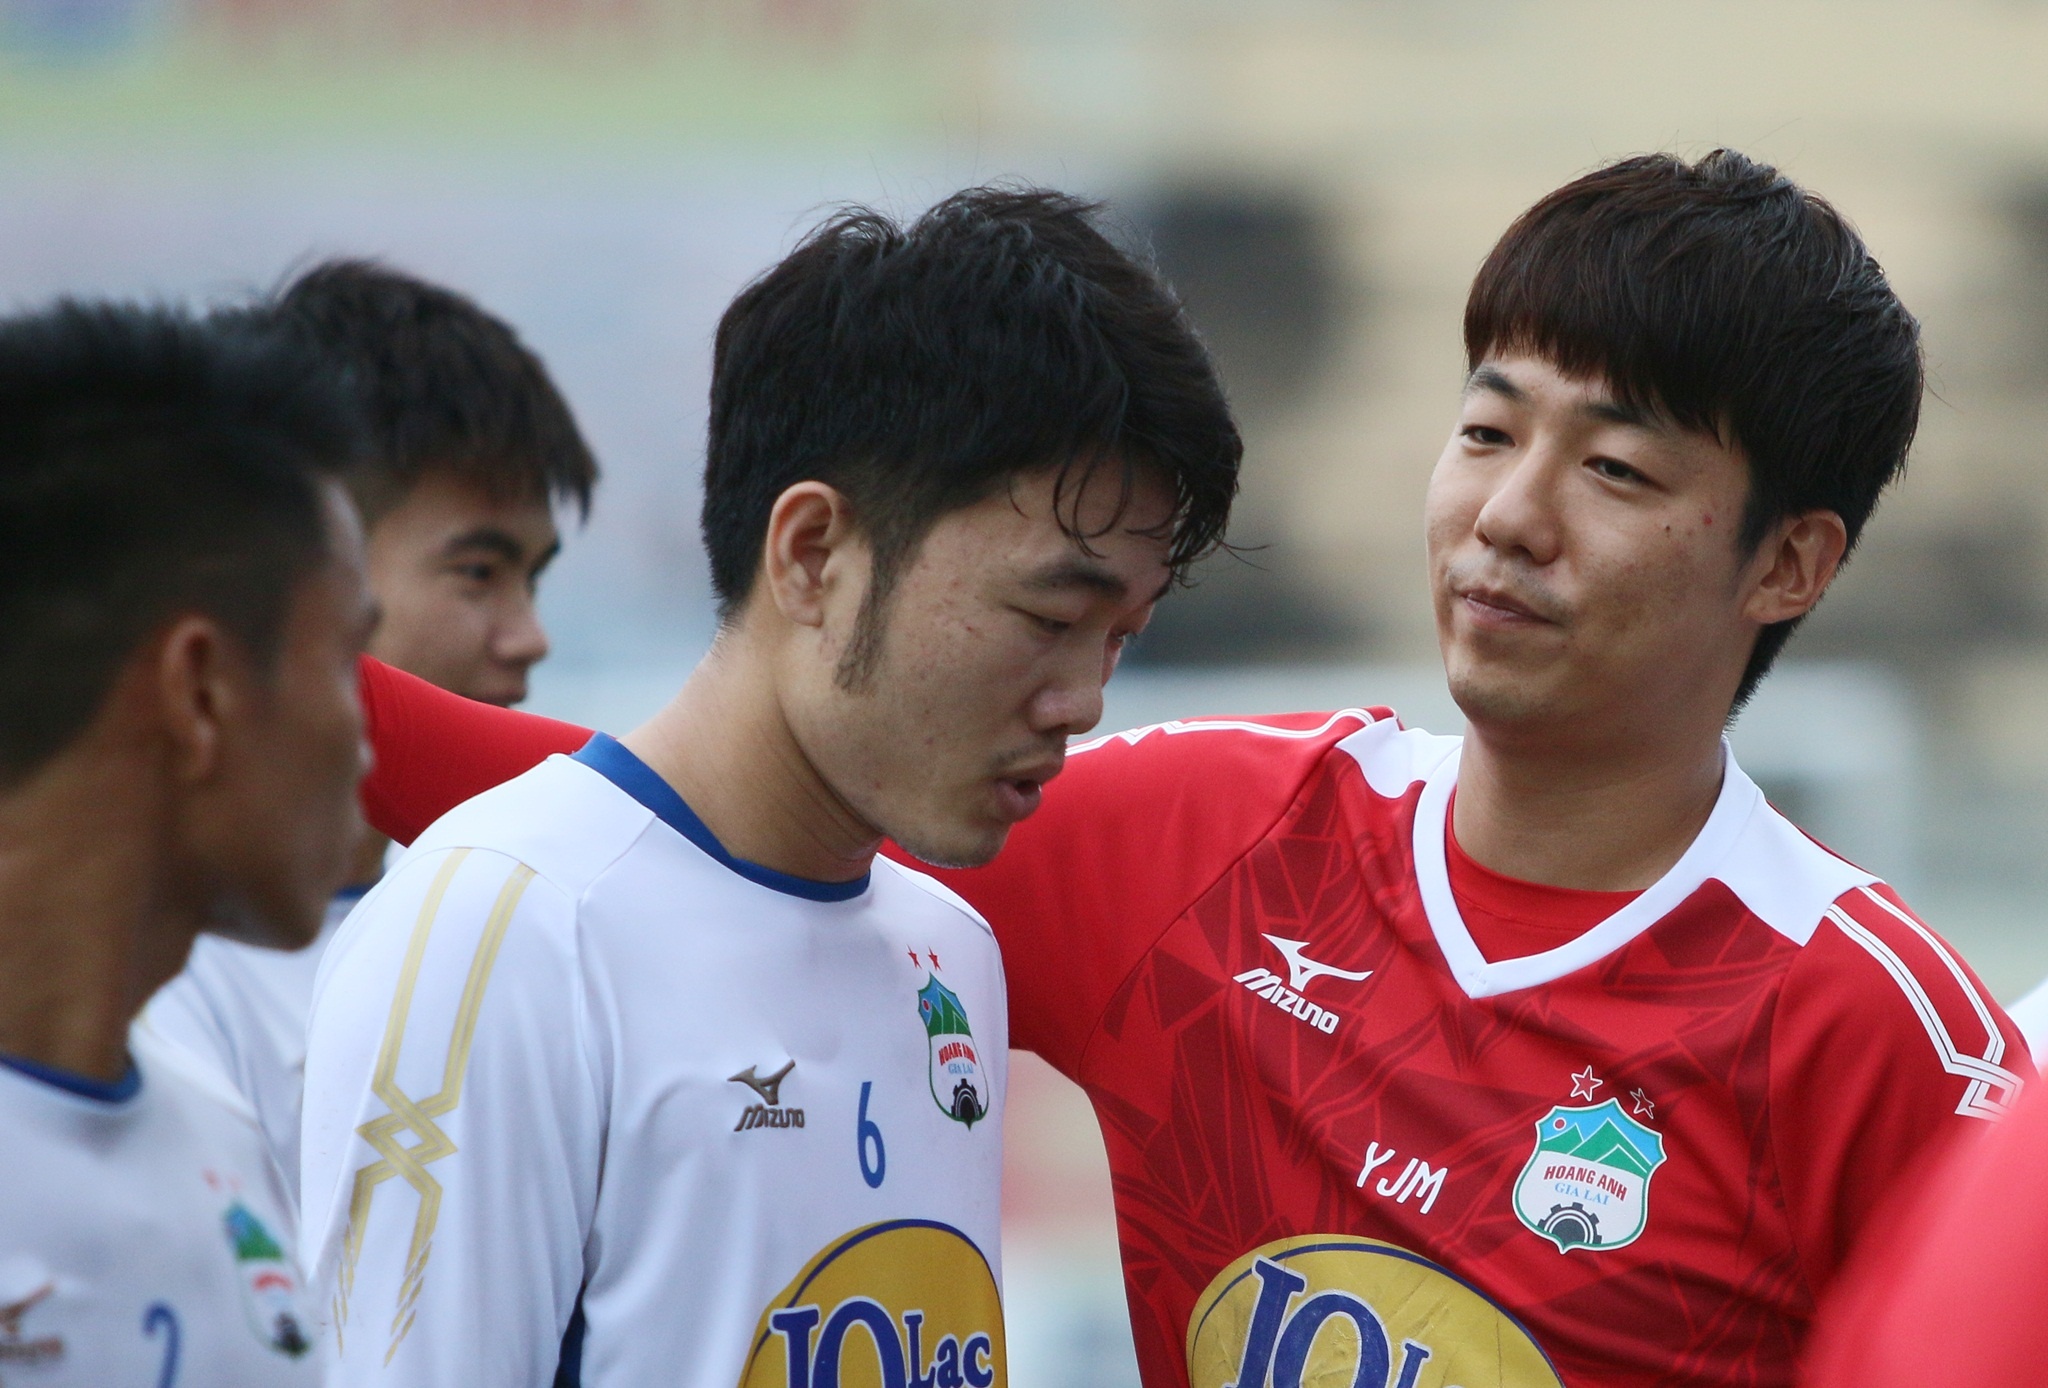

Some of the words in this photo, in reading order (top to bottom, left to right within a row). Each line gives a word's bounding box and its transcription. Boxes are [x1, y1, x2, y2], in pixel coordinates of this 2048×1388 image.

[857, 1081, 886, 1189] 6
[1356, 1141, 1448, 1215] YJM
[1543, 1165, 1597, 1185] HOANG
[1596, 1173, 1629, 1202] ANH
[1554, 1182, 1580, 1198] GIA
[1583, 1188, 1610, 1206] LAI
